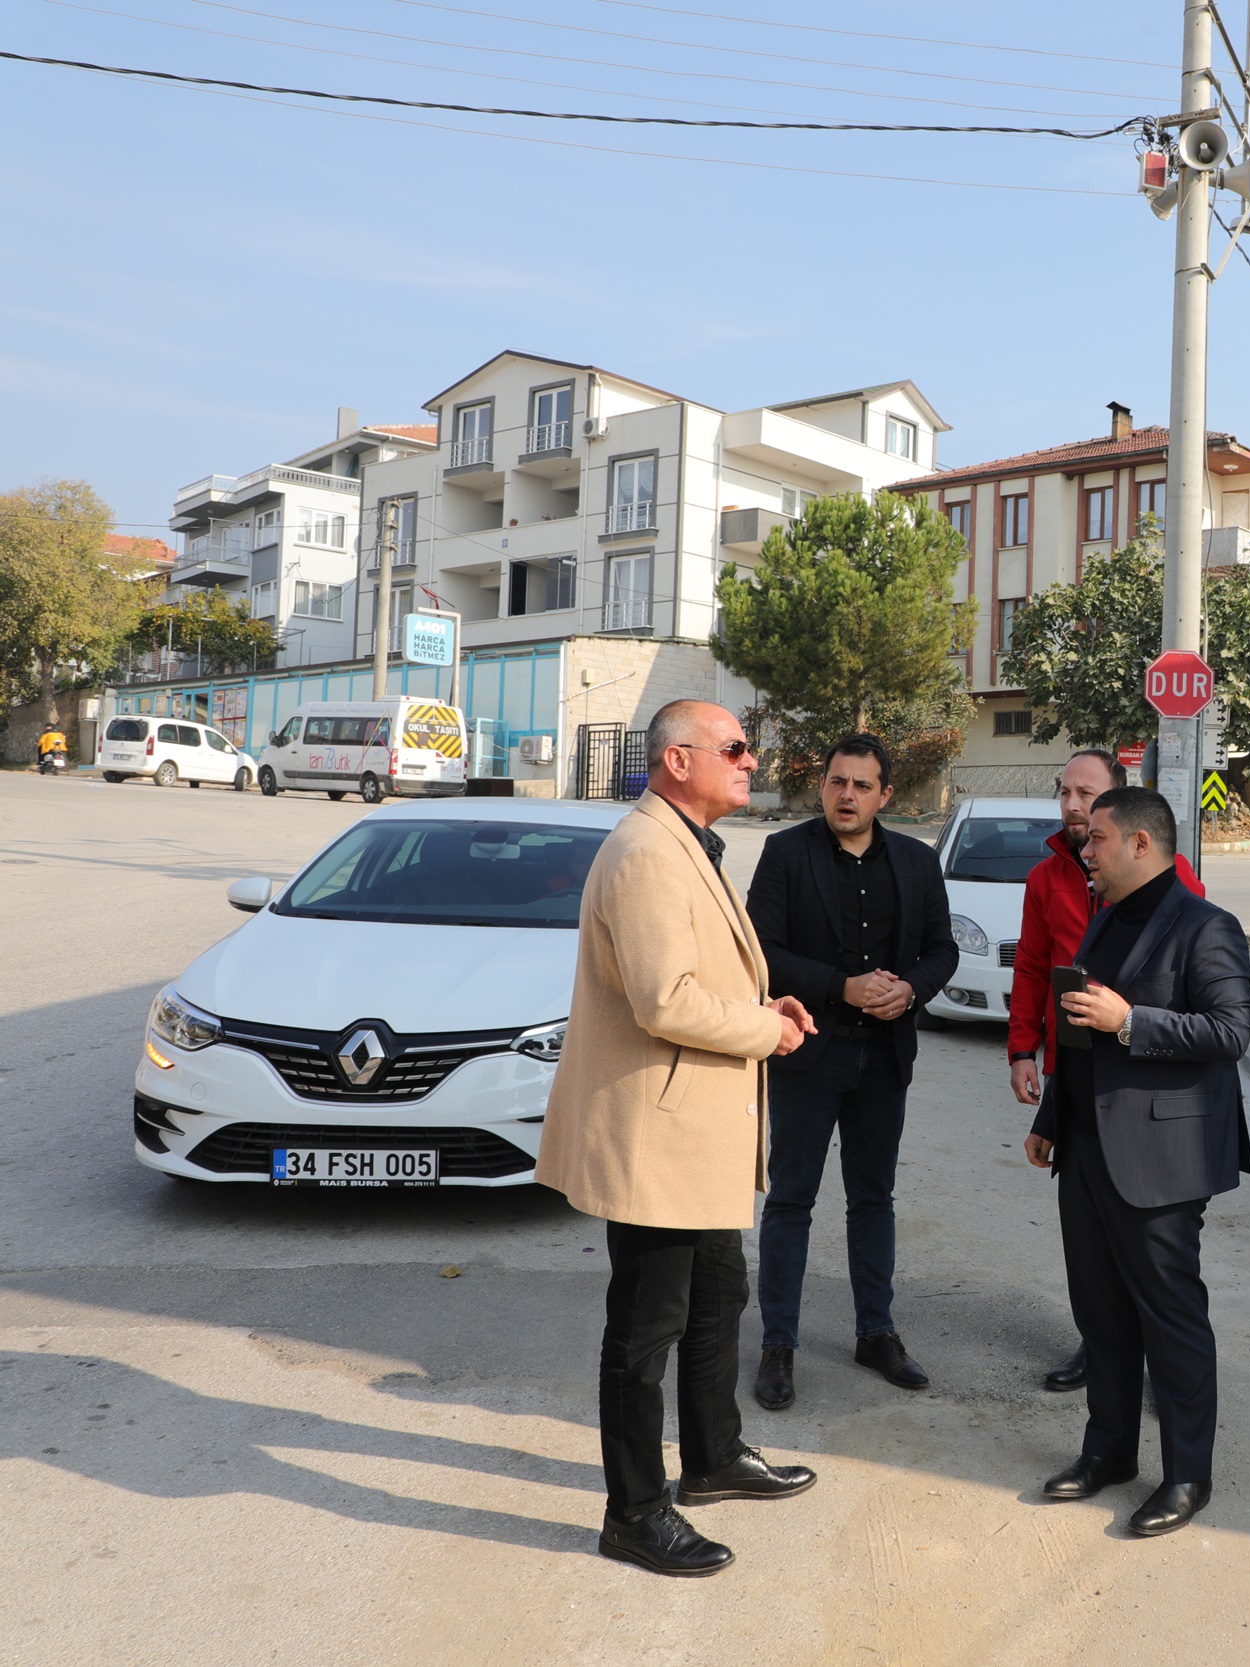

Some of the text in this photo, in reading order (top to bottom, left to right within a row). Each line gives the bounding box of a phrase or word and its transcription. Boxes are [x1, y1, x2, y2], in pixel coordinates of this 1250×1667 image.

[414, 633, 446, 646] HARCA
[414, 641, 446, 654] HARCA
[1151, 671, 1208, 698] DUR
[407, 723, 459, 736] OKUL TAŞITI
[287, 1152, 432, 1177] 34 FSH 005
